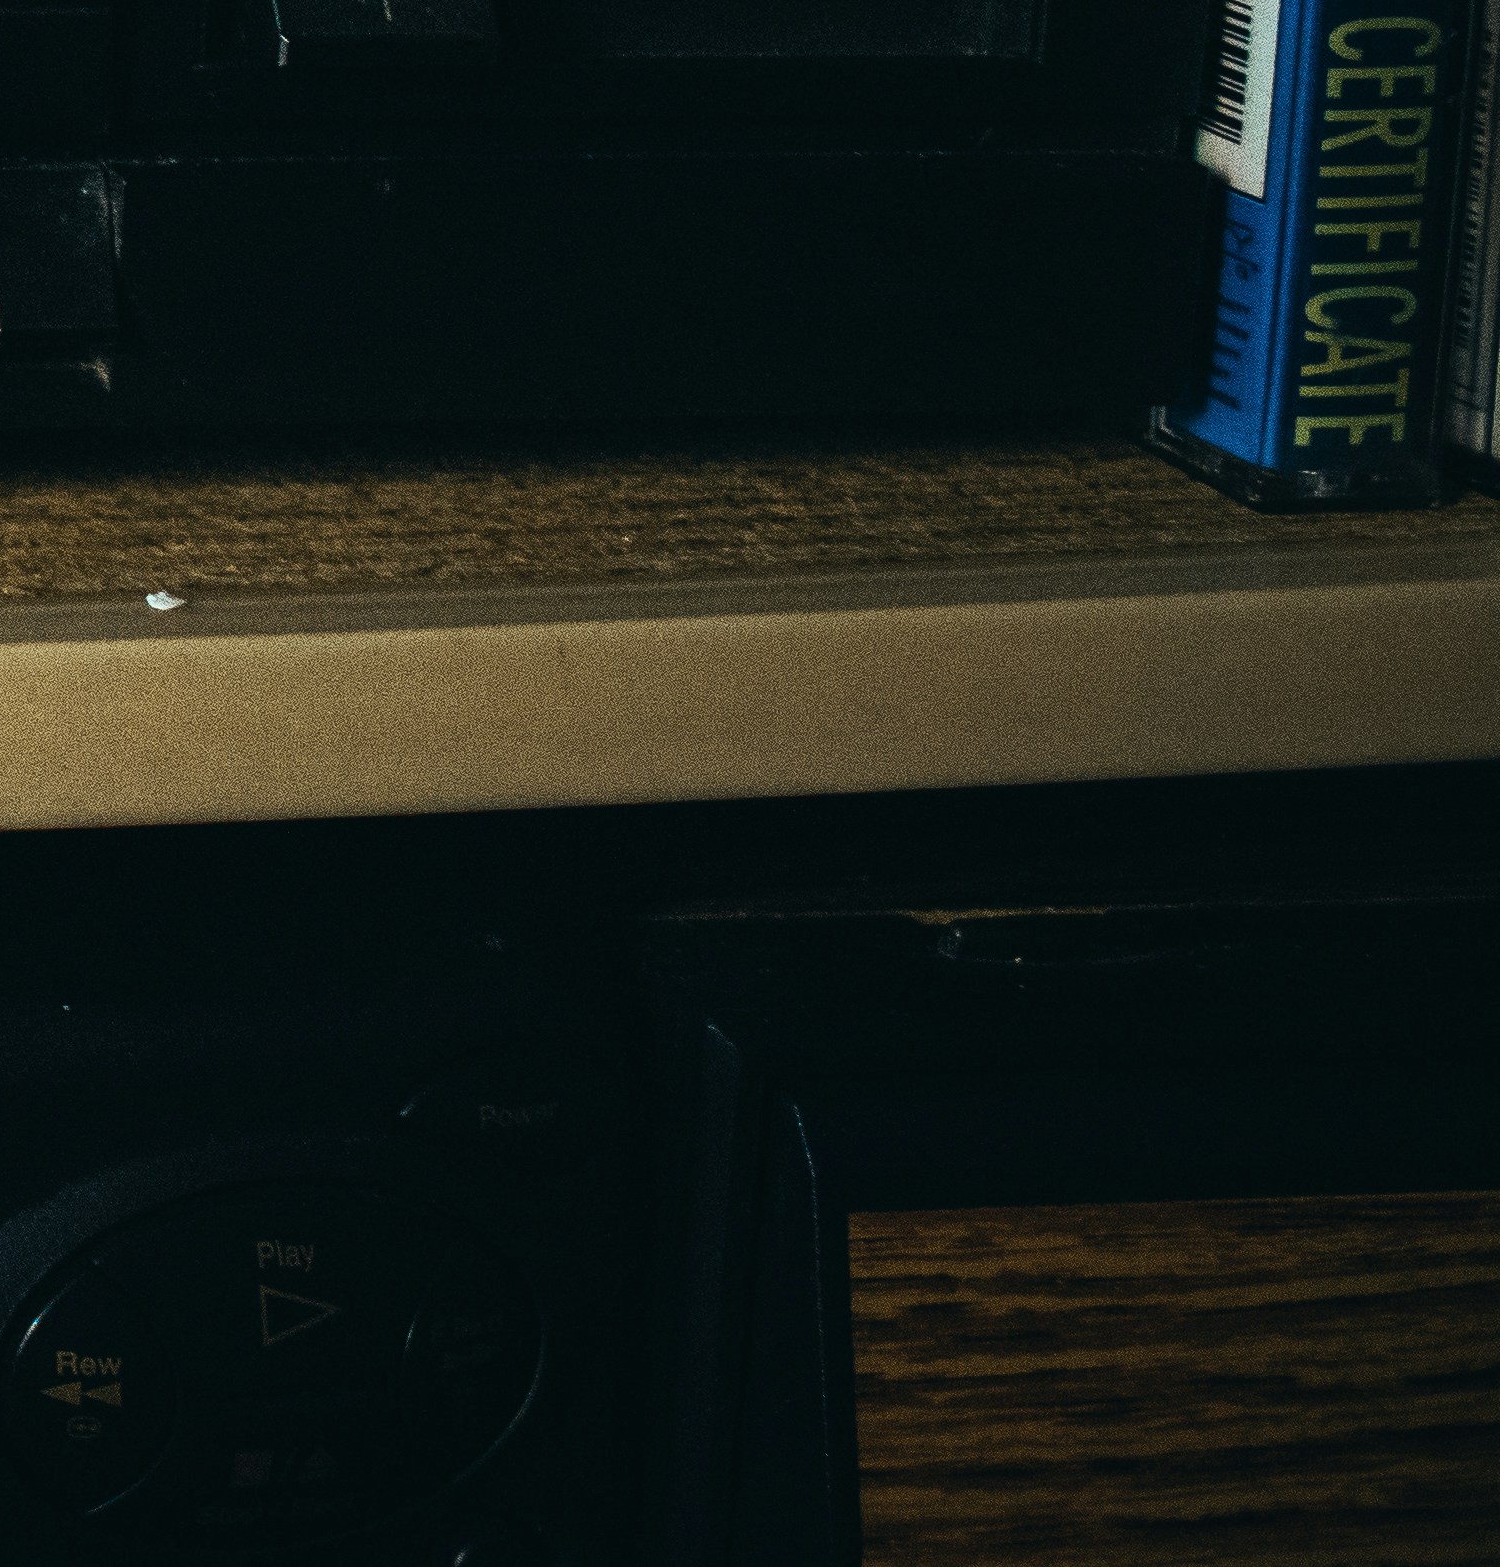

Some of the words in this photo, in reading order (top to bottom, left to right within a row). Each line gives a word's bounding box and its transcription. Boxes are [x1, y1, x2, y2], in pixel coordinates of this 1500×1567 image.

[1293, 16, 1442, 448] CERTIFICATE
[255, 1239, 317, 1272] Play
[56, 1351, 120, 1374] Rew
